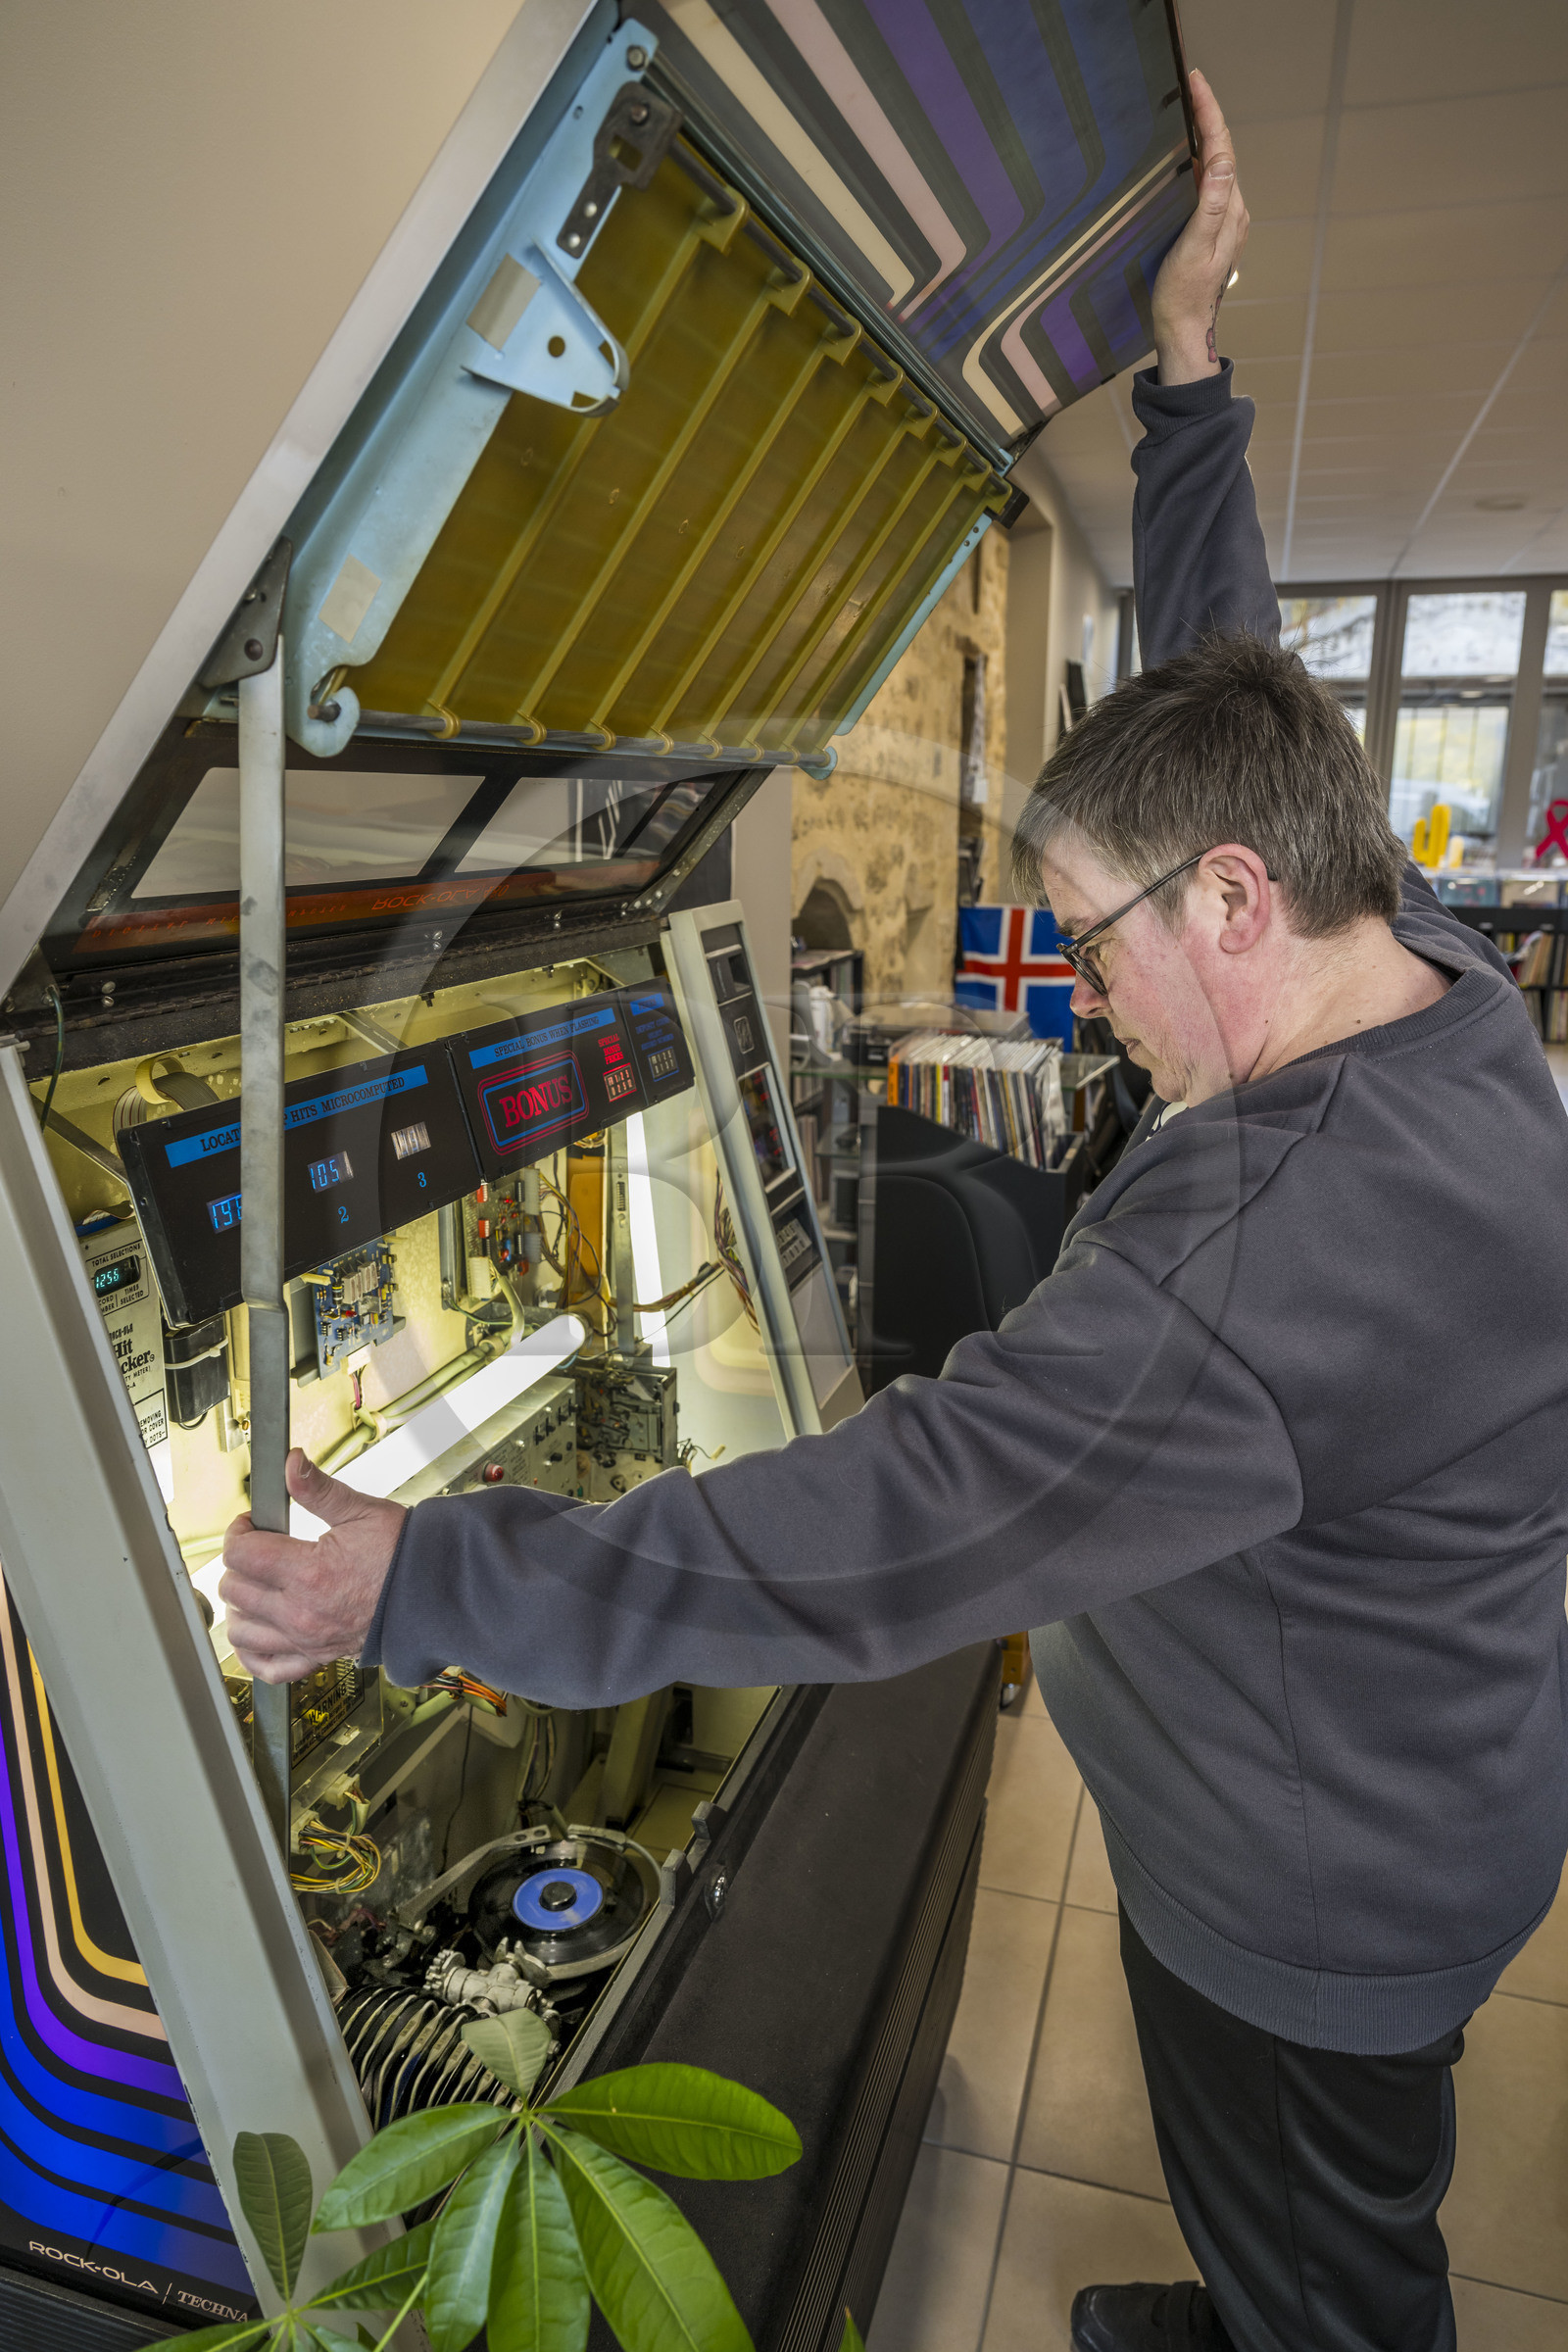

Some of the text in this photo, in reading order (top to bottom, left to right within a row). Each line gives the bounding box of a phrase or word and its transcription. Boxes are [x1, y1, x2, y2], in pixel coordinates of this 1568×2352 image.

[494, 1015, 600, 1058] SPECIAL BONUS WHEN FLASHING
[598, 1033, 619, 1047] SPECIAL
[603, 1044, 621, 1056] BONUS
[605, 1052, 624, 1065] PRICES
[291, 1104, 318, 1124] HITS
[322, 1076, 406, 1113] MICROCOMPUTED
[498, 1074, 573, 1129] BONUS
[309, 1158, 340, 1191] 105
[417, 1171, 427, 1189] 3
[338, 1205, 350, 1224] 2
[92, 1243, 141, 1267] TOTAL SELECTIONS
[120, 1290, 144, 1305] SELECTED
[124, 1284, 139, 1296] TIMES
[113, 1339, 133, 1359] Hit
[139, 1410, 162, 1428] EMOVING
[148, 1417, 164, 1432] COVER
[308, 1682, 347, 1726] WARNING
[28, 2240, 160, 2295] ROCK-OLA
[177, 2289, 250, 2324] TECHNA
